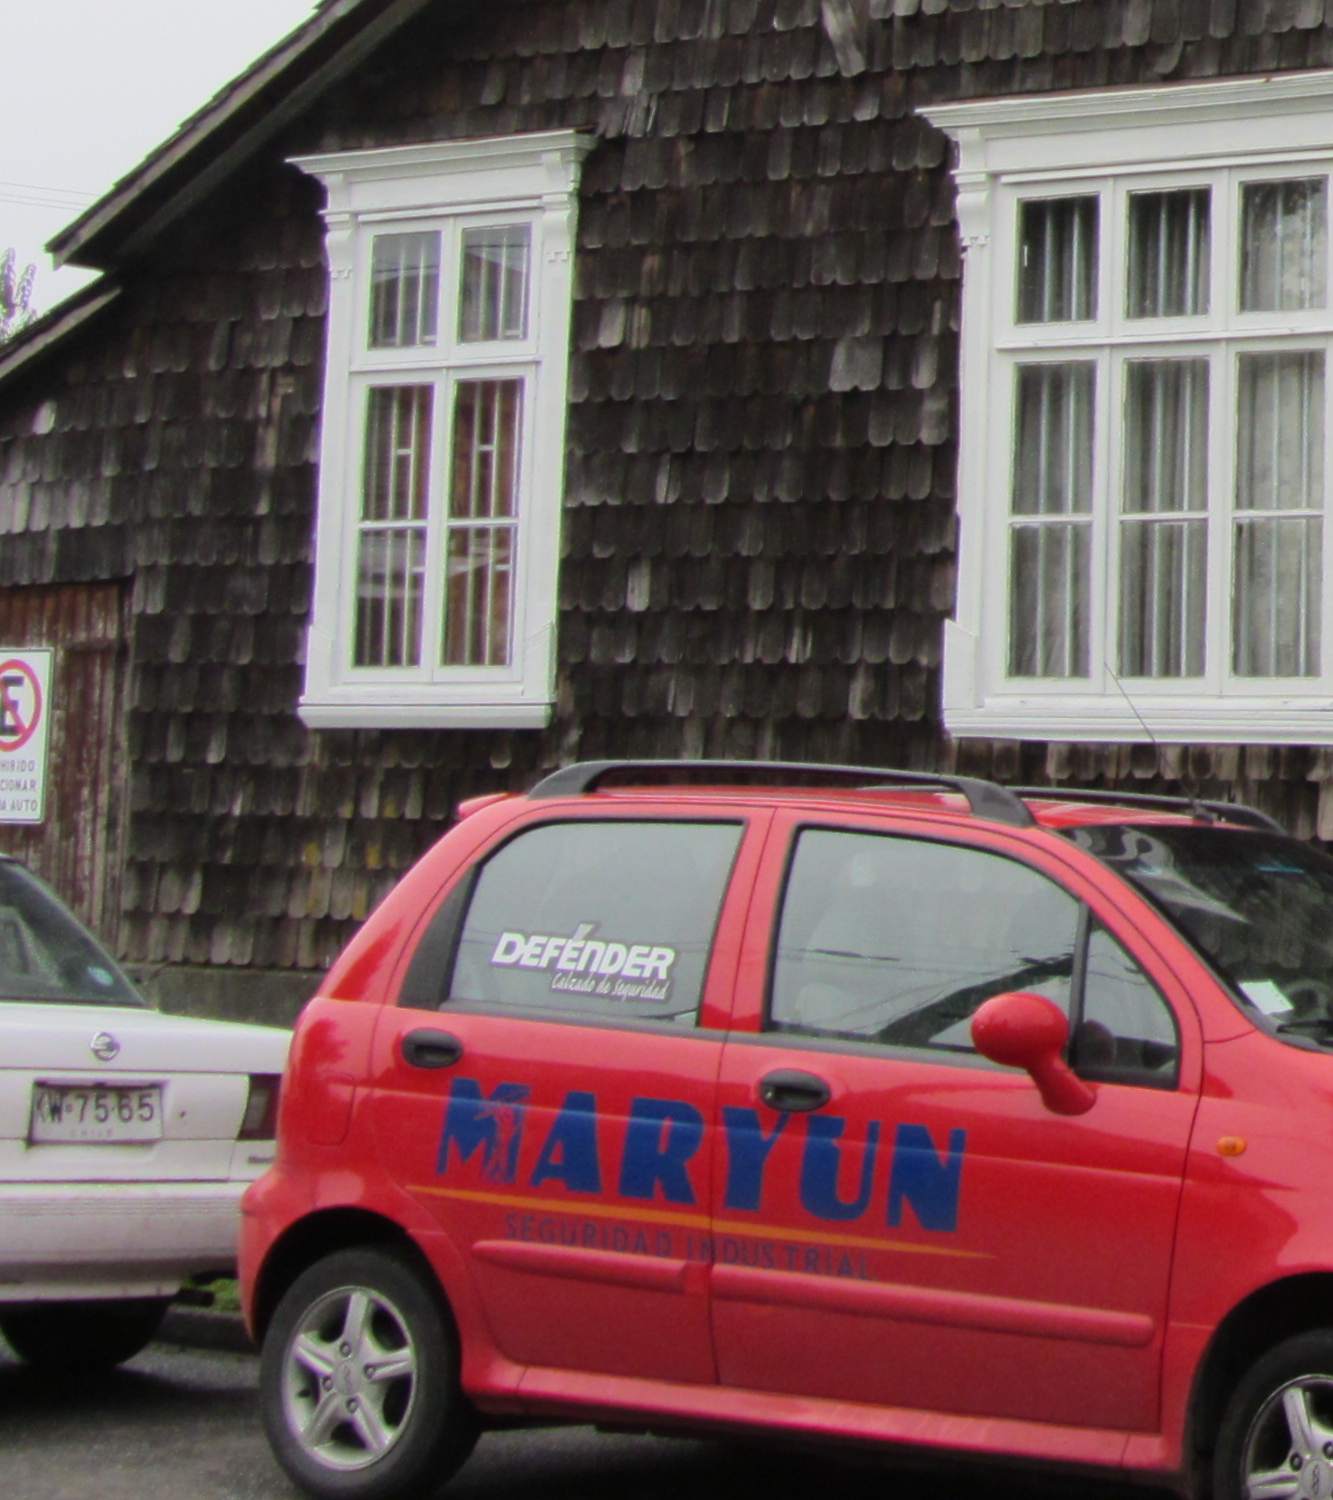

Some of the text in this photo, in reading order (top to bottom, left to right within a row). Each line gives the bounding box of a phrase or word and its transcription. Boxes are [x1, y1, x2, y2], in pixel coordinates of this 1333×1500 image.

[551, 972, 595, 992] Calzado
[595, 974, 611, 994] de
[434, 1077, 968, 1233] MARYUN
[505, 1213, 874, 1282] SEGURIDAD INDUSTRIAL
